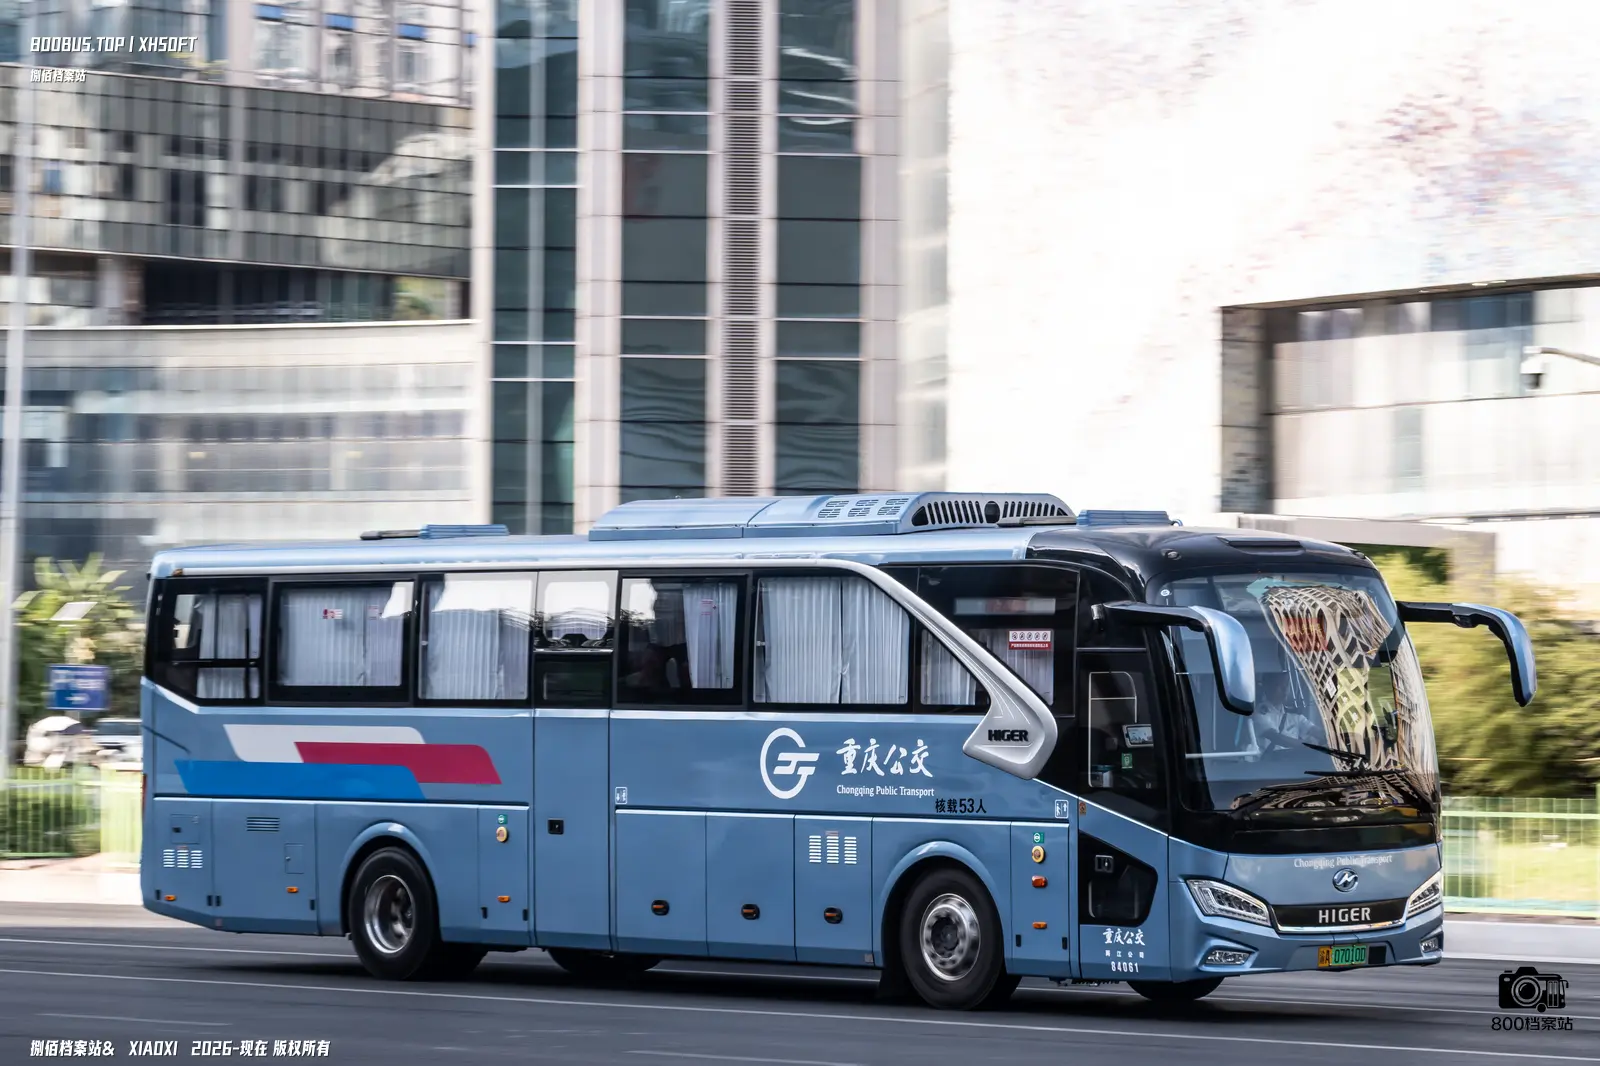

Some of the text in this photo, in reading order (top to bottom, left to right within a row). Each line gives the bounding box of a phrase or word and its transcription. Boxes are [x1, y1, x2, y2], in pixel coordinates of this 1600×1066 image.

[988, 729, 1029, 742] HIGER
[836, 738, 933, 778] 重庆公交
[836, 784, 935, 799] Chongqing Public Transport
[935, 798, 987, 814] 核载53人
[1318, 907, 1371, 924] HIGER
[1103, 928, 1146, 946] 重庆公交
[1111, 961, 1139, 973] 84061
